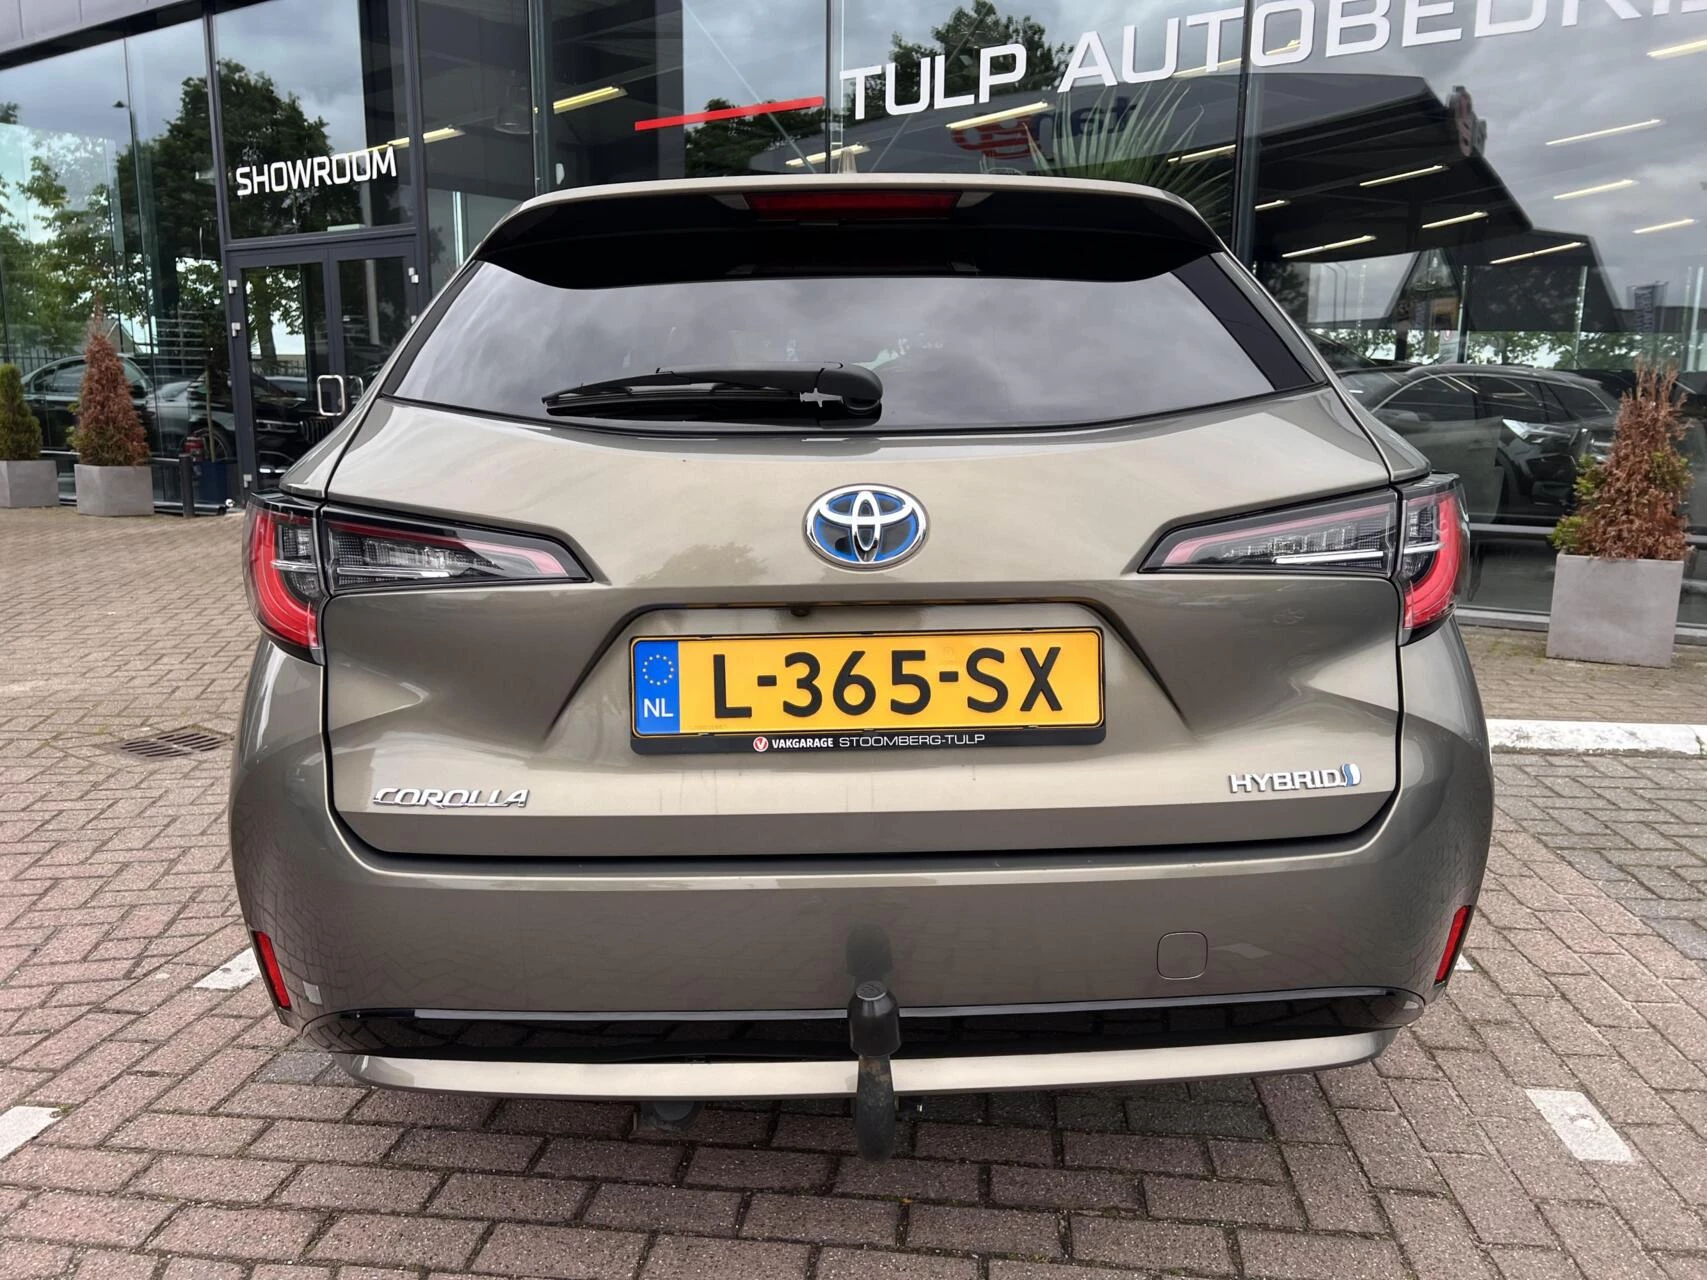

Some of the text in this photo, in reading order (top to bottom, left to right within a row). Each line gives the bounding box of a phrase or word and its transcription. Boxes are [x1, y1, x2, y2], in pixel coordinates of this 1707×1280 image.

[839, 0, 1707, 120] TULP AUTOBED
[235, 146, 397, 196] SHOWROOM
[712, 646, 1063, 720] L-365-SX
[643, 698, 674, 718] NL
[771, 737, 834, 749] VAKGARAGE
[839, 734, 985, 748] STOOMBERG-TULP
[1229, 769, 1346, 793] HYBRID
[373, 788, 530, 808] COROLLA
